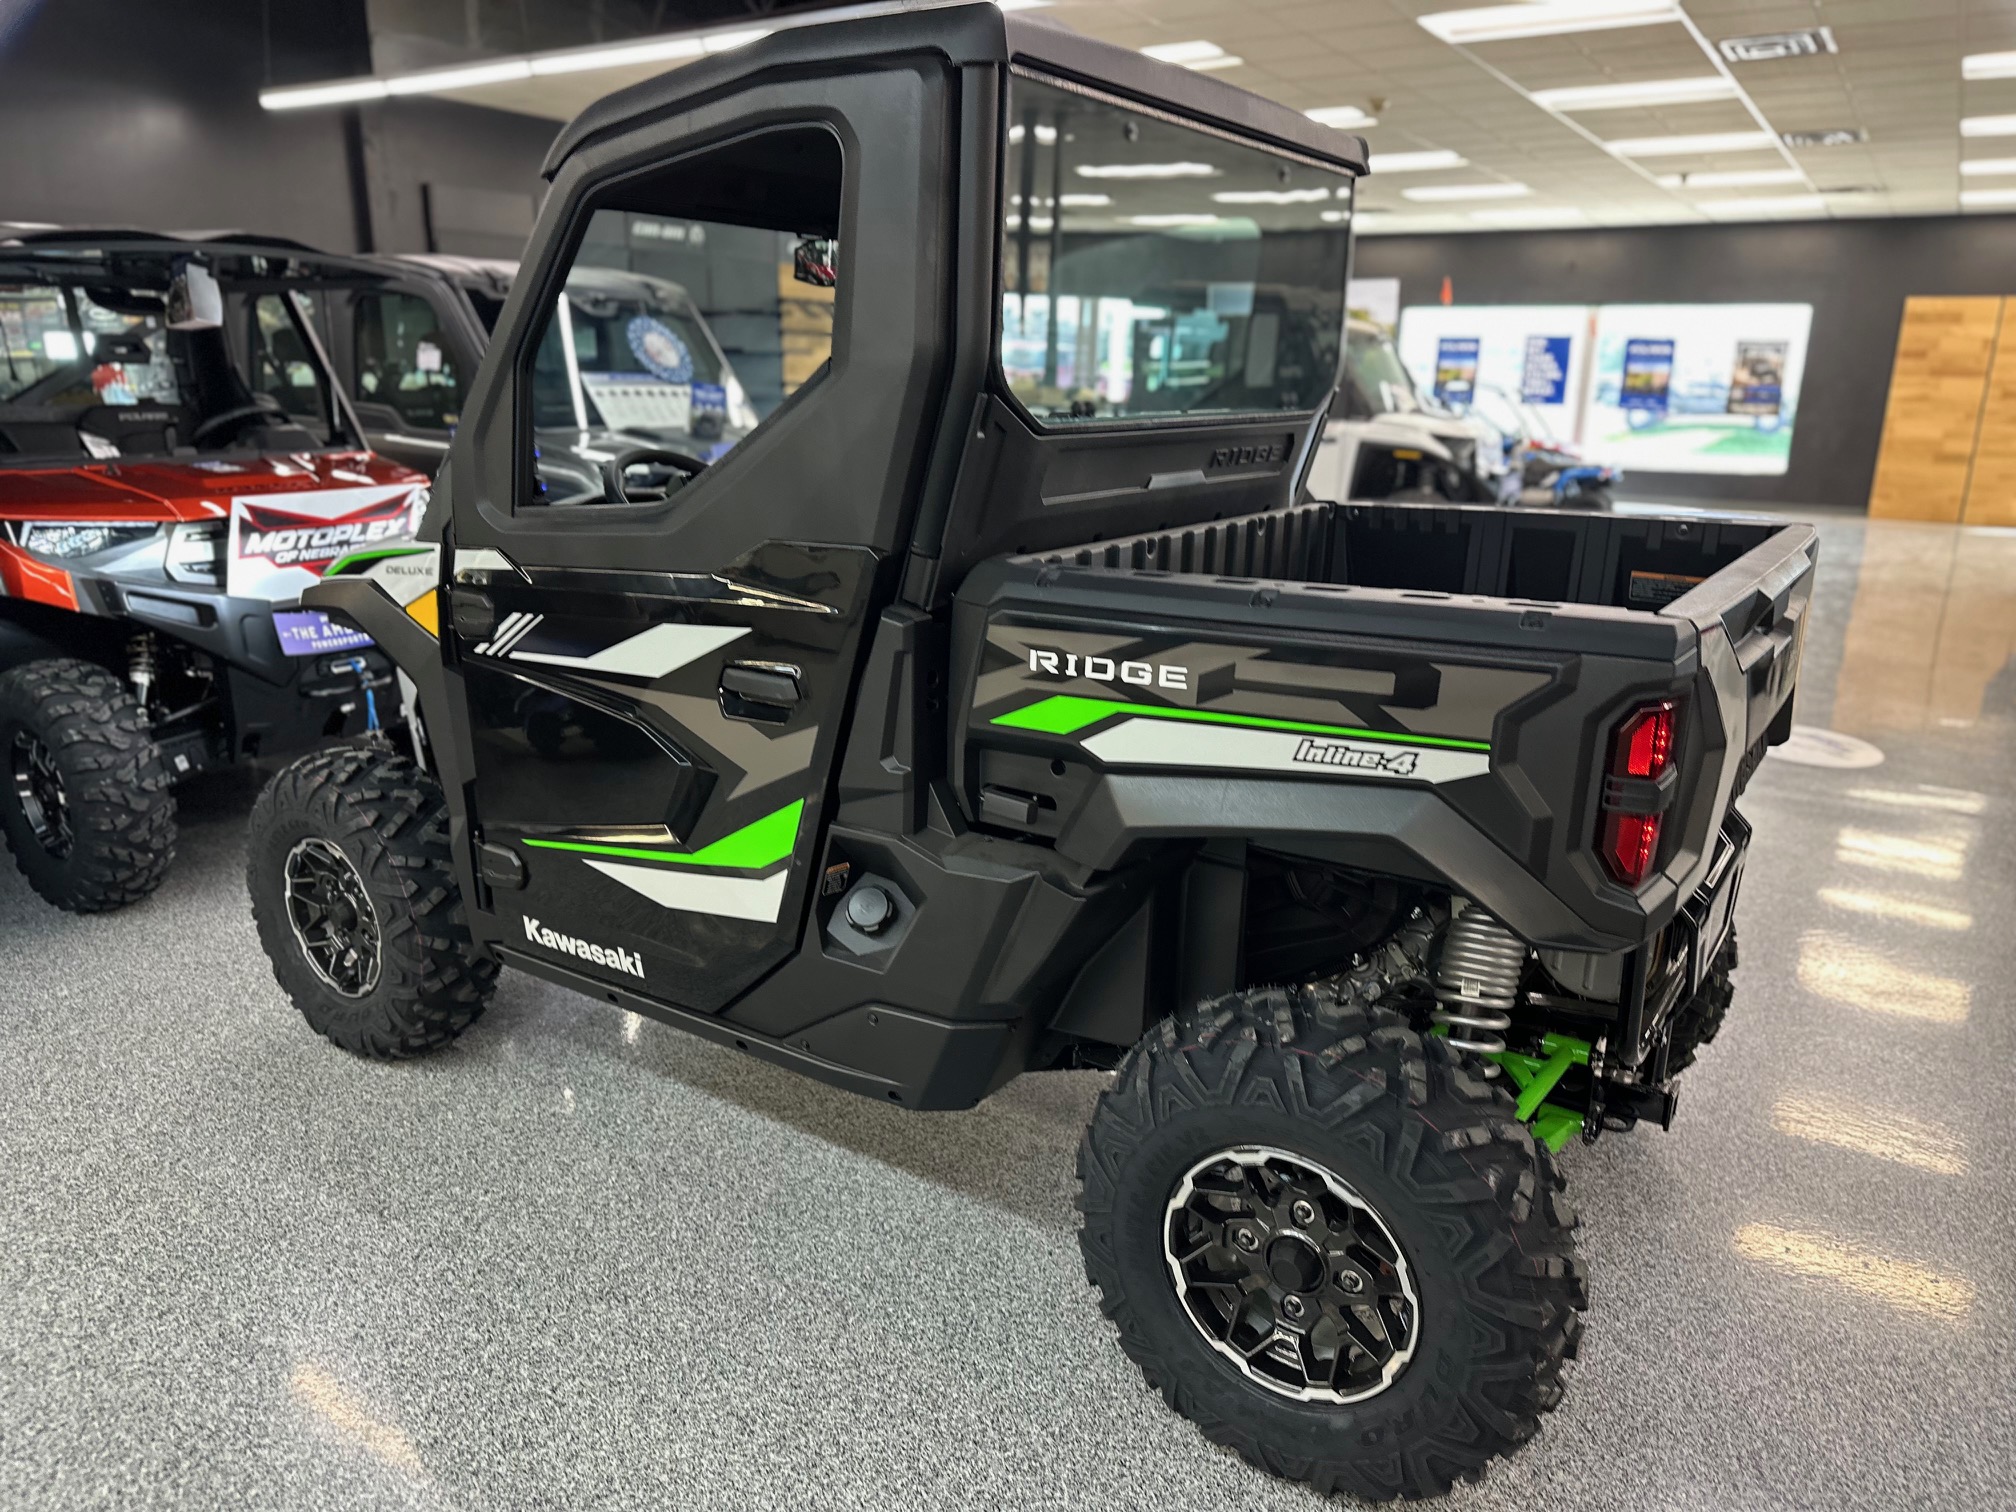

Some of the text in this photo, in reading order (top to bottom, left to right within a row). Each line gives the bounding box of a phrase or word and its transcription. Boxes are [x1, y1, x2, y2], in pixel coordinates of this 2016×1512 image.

[1208, 446, 1284, 468] RIDGE
[244, 517, 406, 556] MOTOPLEX
[274, 542, 366, 565] OF NEBRA
[385, 564, 434, 577] DELUXE
[291, 625, 319, 640] THE
[1028, 648, 1188, 690] RIDGE
[1293, 739, 1418, 775] Inline-4
[522, 914, 646, 979] Kawasaki
